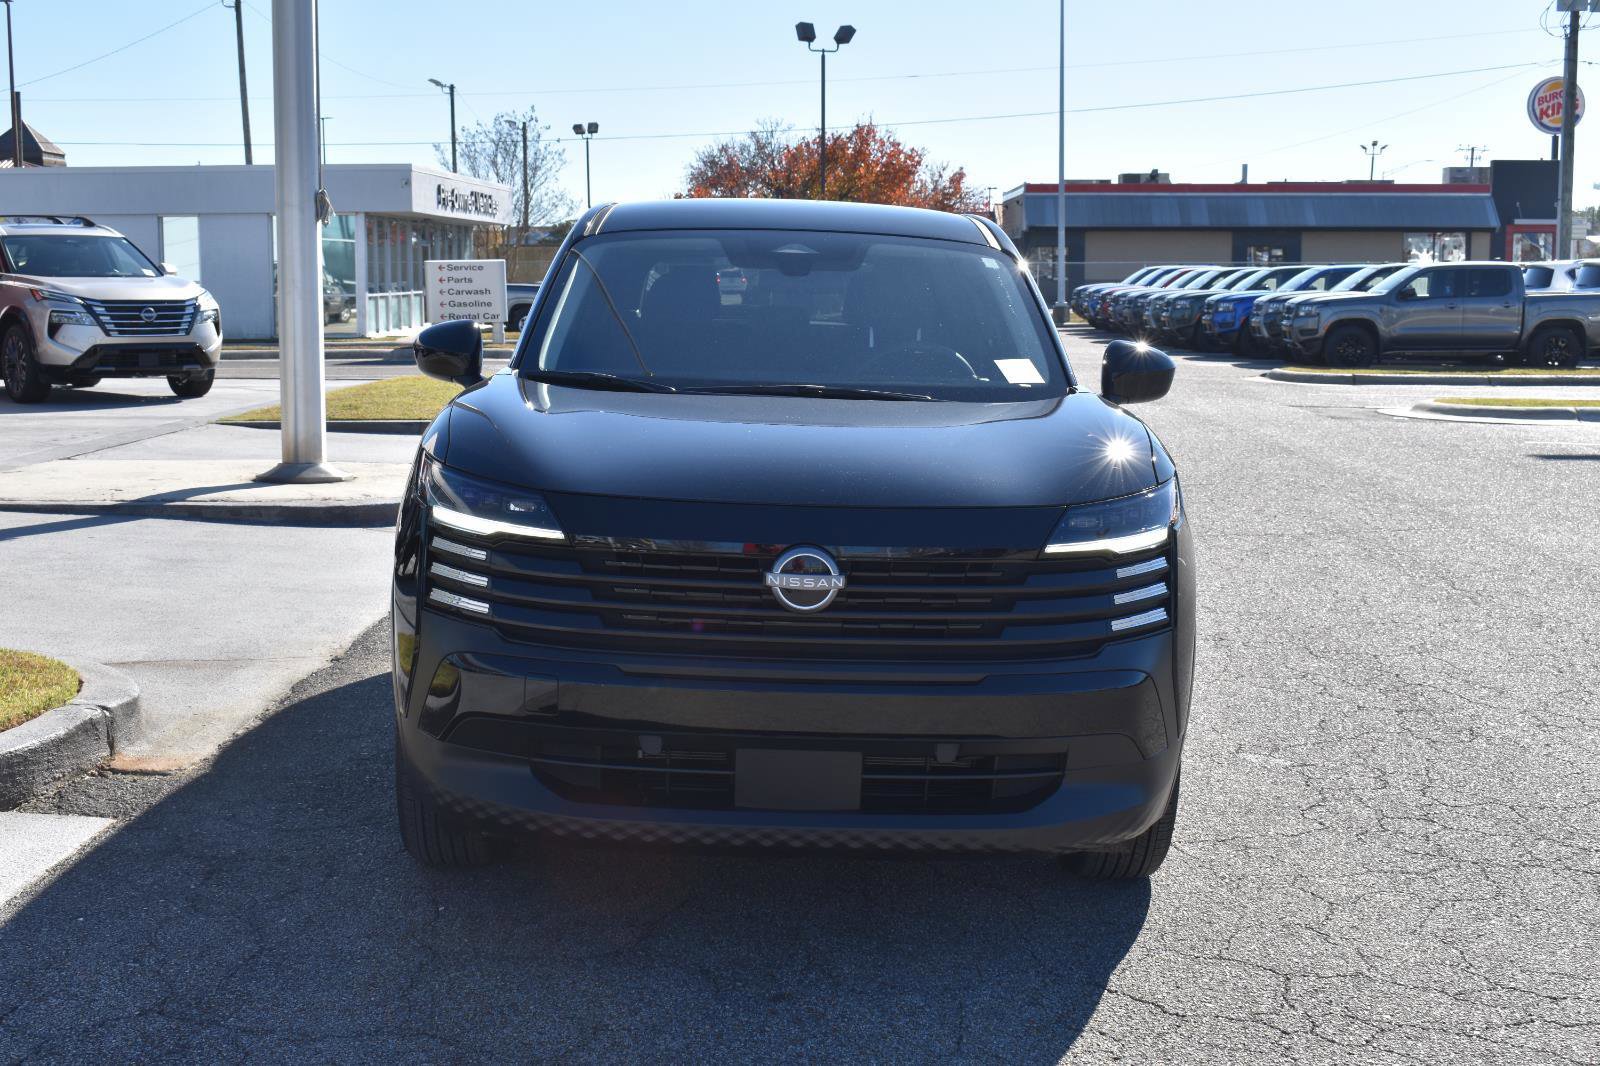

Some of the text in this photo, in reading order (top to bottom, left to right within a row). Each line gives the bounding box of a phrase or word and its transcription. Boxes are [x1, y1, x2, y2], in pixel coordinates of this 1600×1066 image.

[446, 263, 484, 272] Service
[447, 276, 473, 284] Parts
[447, 288, 491, 296] Carwash
[448, 300, 492, 308] Gasoline
[448, 312, 501, 320] Rental Car
[767, 575, 844, 588] NISSAN
